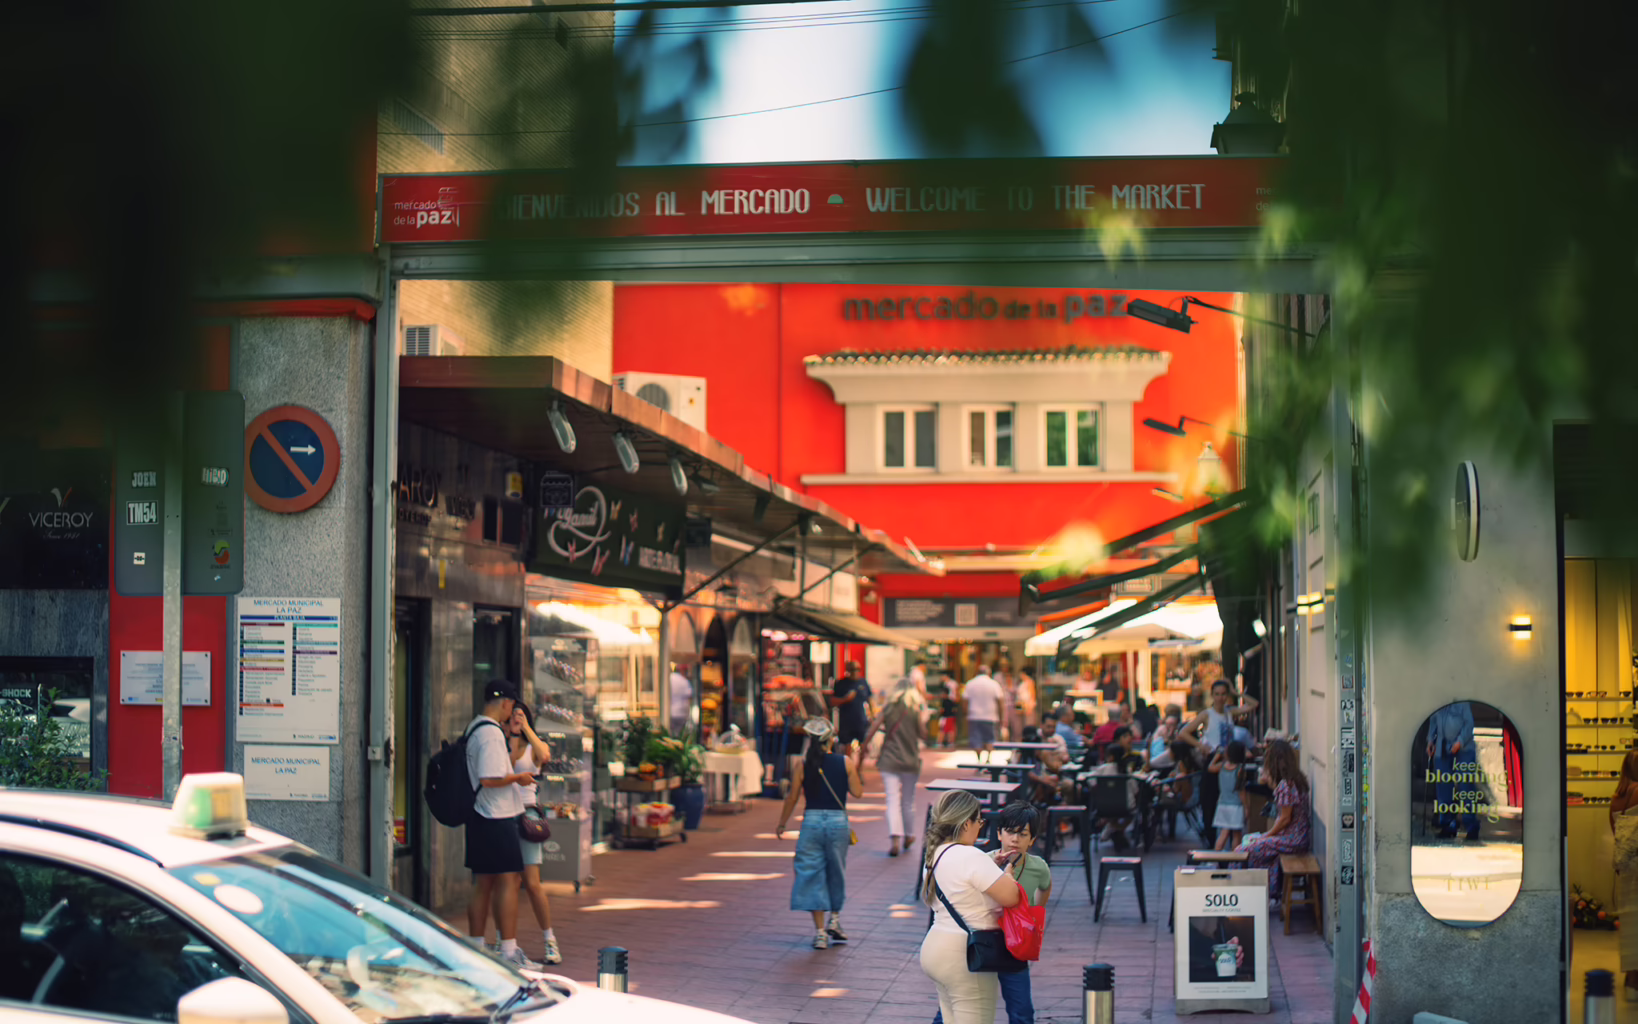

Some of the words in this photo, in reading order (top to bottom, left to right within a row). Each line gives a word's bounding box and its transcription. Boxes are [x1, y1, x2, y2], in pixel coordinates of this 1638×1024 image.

[394, 200, 437, 210] mercado
[655, 191, 685, 216] AL
[700, 188, 810, 215] MERCADO
[866, 186, 986, 213] WELCOME
[1008, 186, 1034, 211] TO
[1053, 185, 1095, 210] THE
[1112, 183, 1206, 210] MARKET
[394, 215, 406, 225] de
[407, 215, 416, 225] la
[416, 211, 452, 229] paz
[845, 291, 1001, 320] mercado
[1003, 300, 1033, 320] de
[1038, 300, 1059, 319] la
[1063, 294, 1130, 325] paz
[29, 512, 93, 528] VICEROY
[128, 501, 157, 524] TM54
[253, 599, 288, 607] MERCADO
[288, 599, 324, 607] MUNICIPAL
[251, 757, 285, 765] MERCADO
[286, 757, 321, 767] MUNICIPAL
[1452, 757, 1484, 774] keep
[275, 767, 284, 775] LA
[284, 767, 297, 775] PAZ
[1452, 787, 1484, 803] keep
[1433, 800, 1500, 824] looking
[1205, 893, 1239, 907] SOLO
